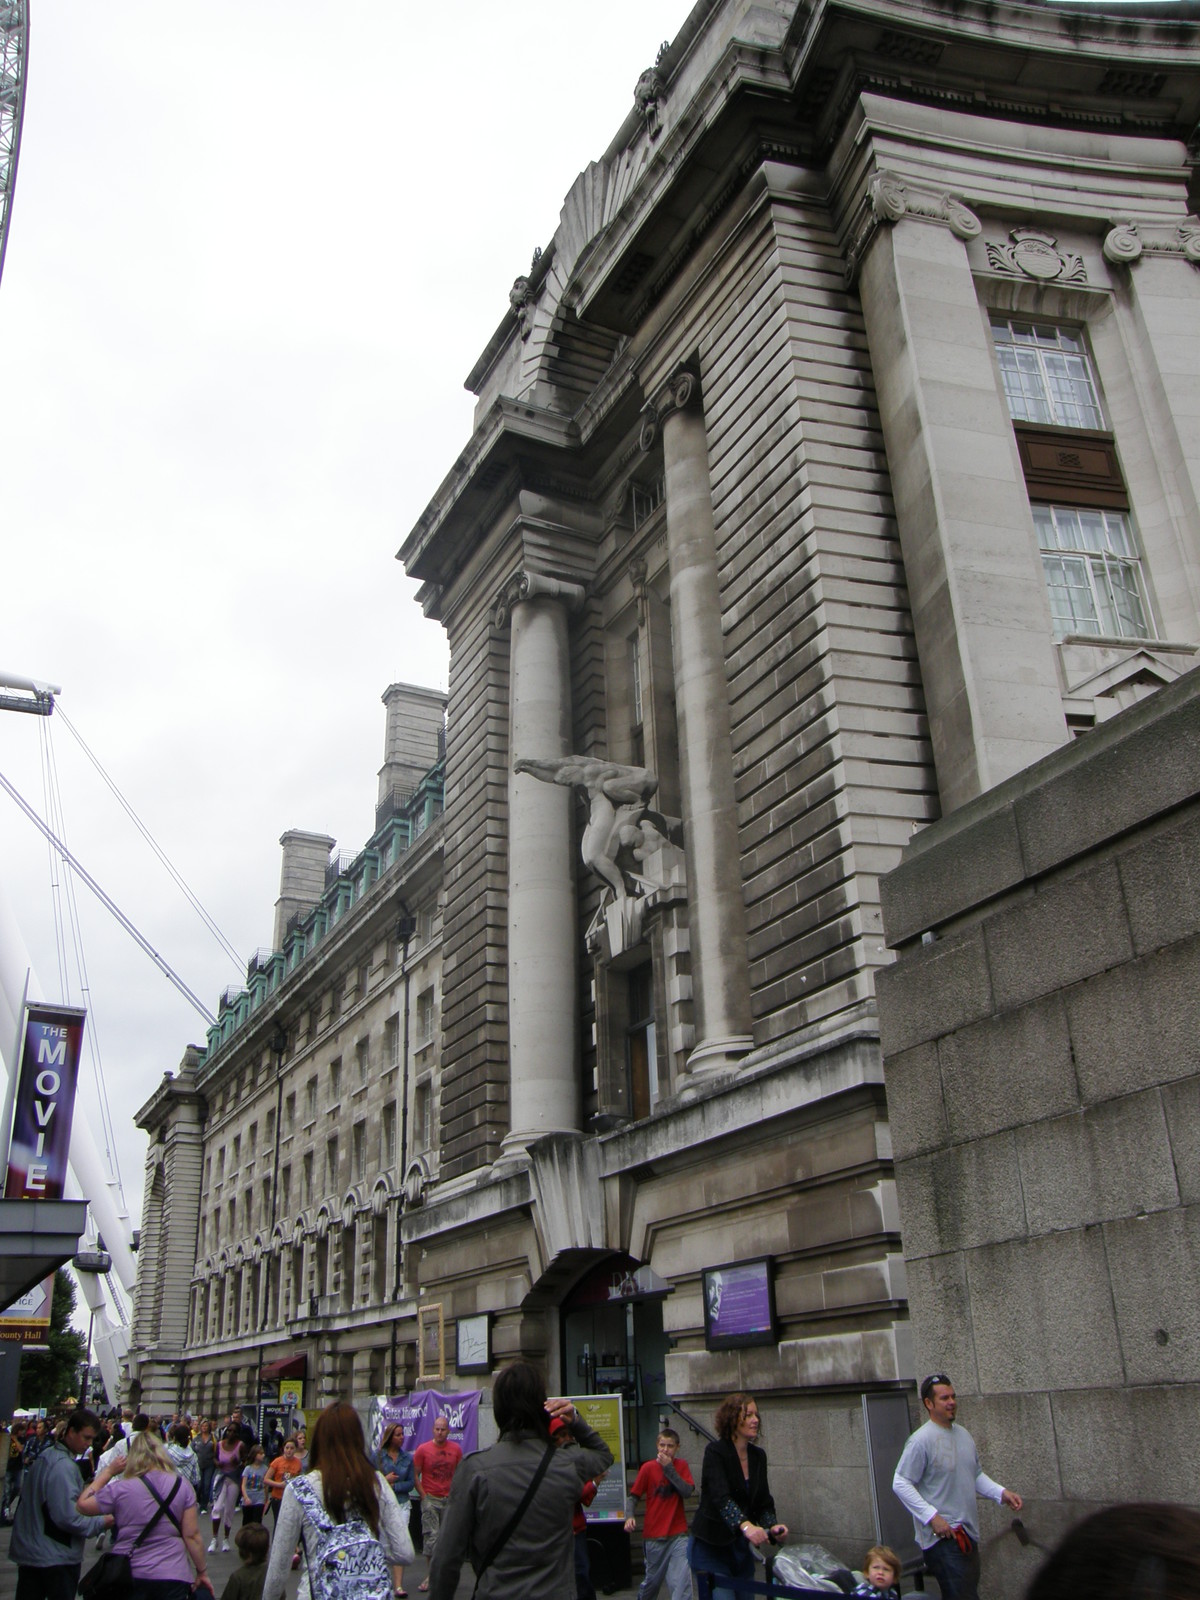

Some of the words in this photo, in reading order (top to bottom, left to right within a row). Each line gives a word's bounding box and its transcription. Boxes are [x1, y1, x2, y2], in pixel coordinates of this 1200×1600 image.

[42, 1026, 68, 1038] THE
[0, 1331, 22, 1341] ounty
[24, 1331, 42, 1339] Hall
